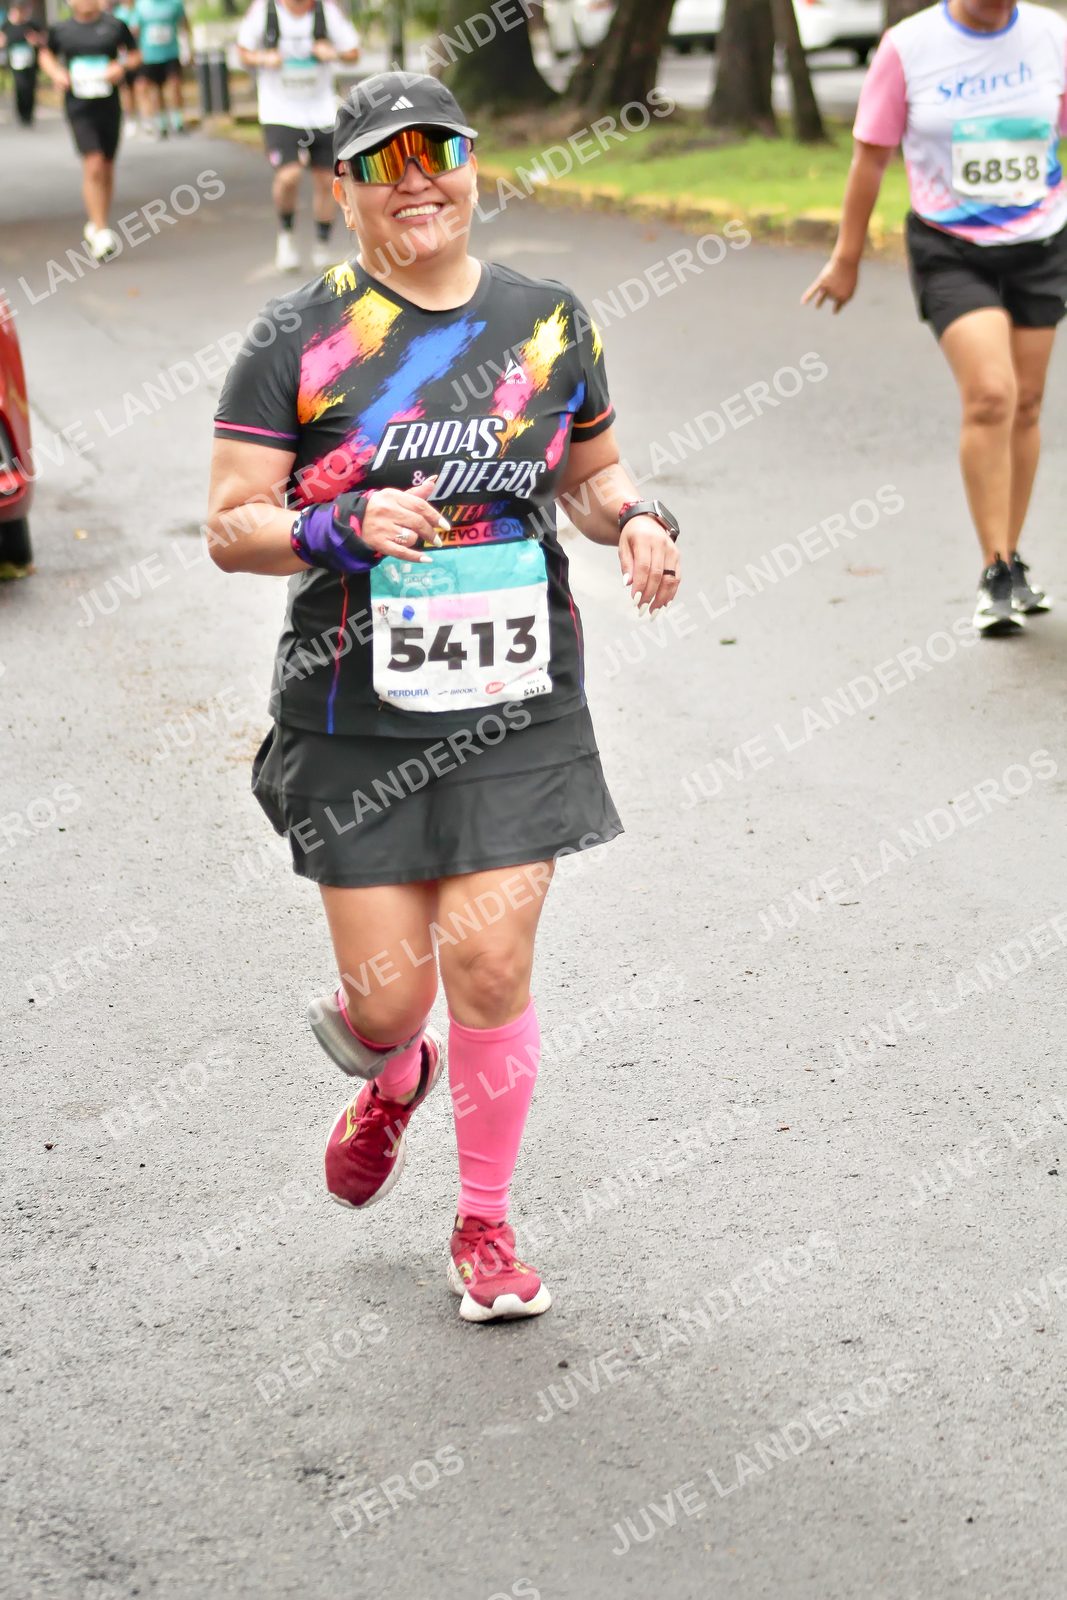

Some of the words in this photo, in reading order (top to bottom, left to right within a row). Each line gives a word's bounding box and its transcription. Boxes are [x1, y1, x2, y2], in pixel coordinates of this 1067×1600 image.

[962, 156, 1039, 185] 6858
[371, 418, 503, 471] FRIDAS
[411, 470, 425, 486] &
[427, 460, 546, 501] DIEGOS
[387, 615, 537, 672] 5413
[387, 688, 429, 697] PERDURA
[524, 685, 546, 697] 5413
